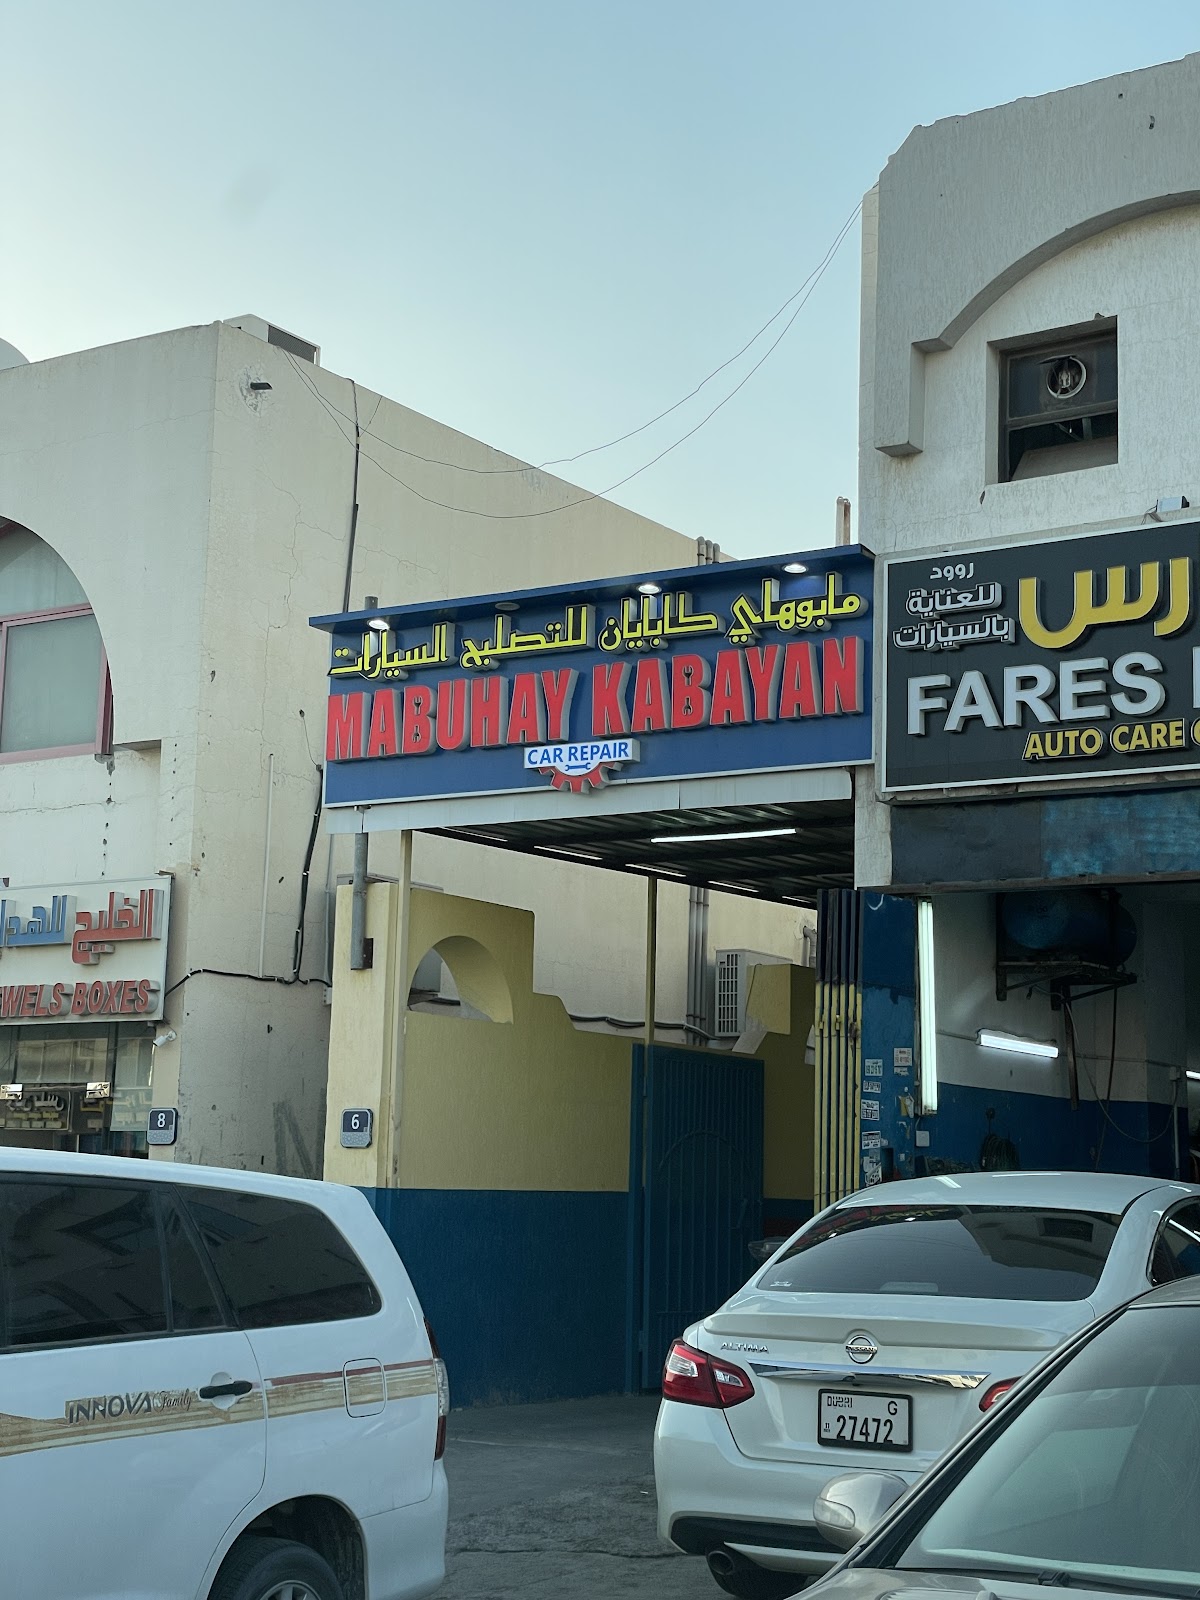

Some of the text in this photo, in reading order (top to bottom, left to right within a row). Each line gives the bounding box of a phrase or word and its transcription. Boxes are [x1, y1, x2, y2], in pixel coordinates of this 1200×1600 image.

[929, 562, 974, 581] روود
[906, 583, 998, 618] للعناية
[461, 605, 589, 669] للتصليح
[894, 615, 1010, 649] بالسيارات
[329, 623, 449, 679] السيارات
[326, 635, 863, 762] MABUHAY KABAYAN
[907, 651, 1165, 736] FARES
[527, 741, 630, 765] CAR REPAIR
[1024, 728, 1101, 759] AUTO
[1112, 720, 1183, 752] CARE
[72, 888, 158, 965] الخليج
[0, 978, 153, 1018] WELS BOXES
[157, 1112, 166, 1128] 8
[351, 1113, 360, 1130] 6
[720, 1341, 769, 1354] ALTIMA
[887, 1400, 898, 1416] G
[836, 1414, 894, 1444] 27472
